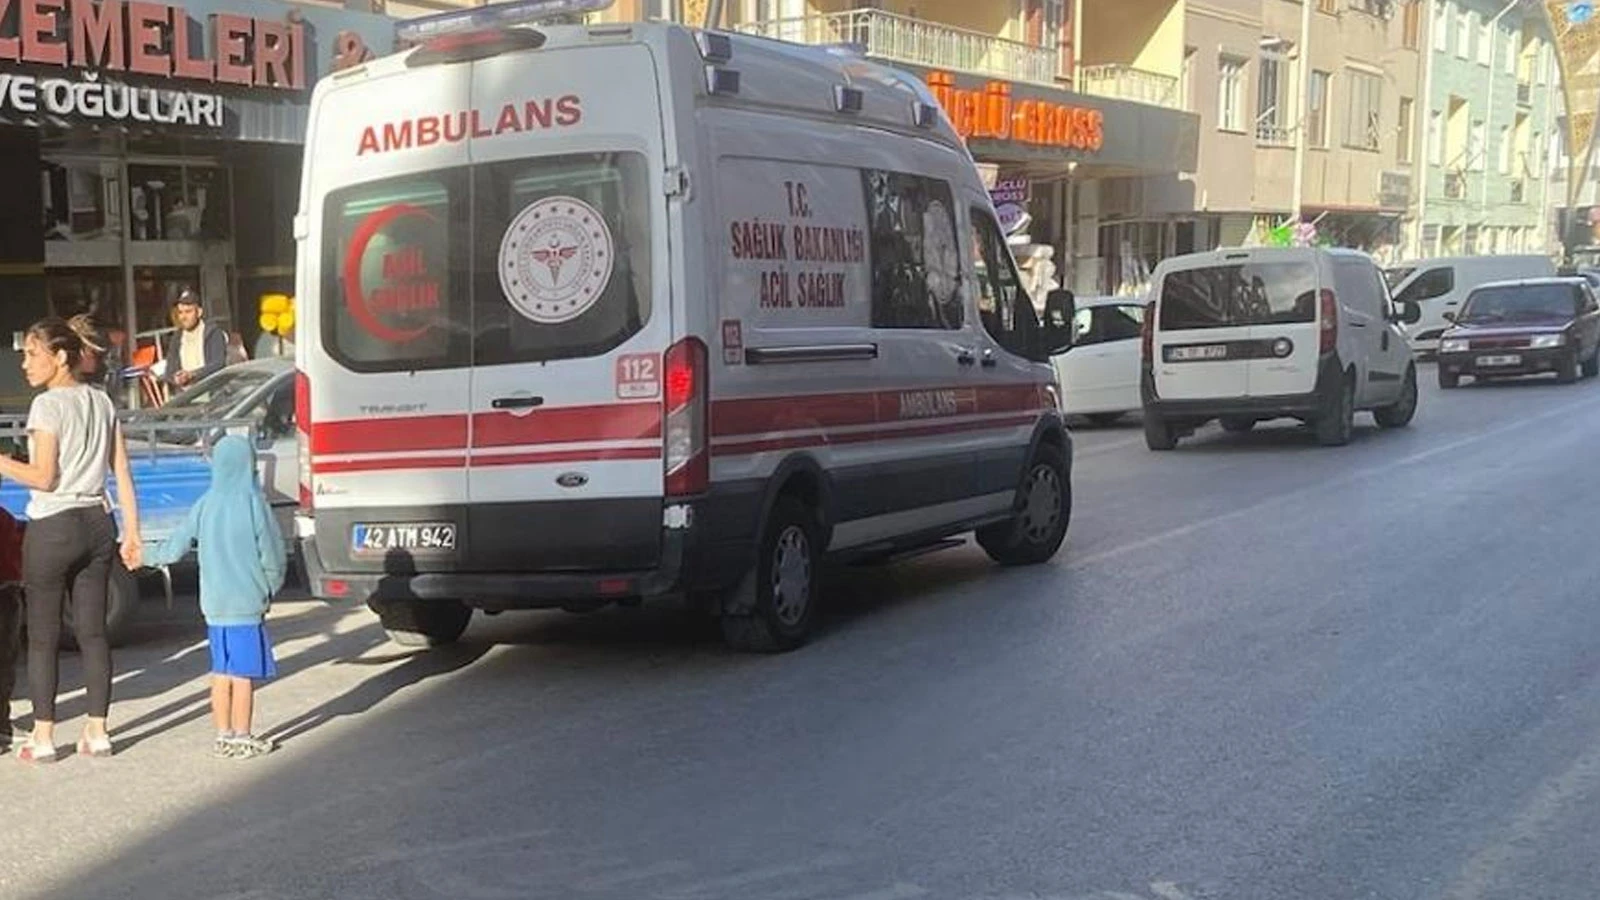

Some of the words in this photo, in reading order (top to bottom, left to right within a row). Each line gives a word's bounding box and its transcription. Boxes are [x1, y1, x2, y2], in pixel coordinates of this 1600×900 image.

[43, 71, 223, 126] OĞULLARI
[357, 95, 582, 156] AMBULANS
[784, 181, 812, 218] T.C.
[731, 217, 787, 260] SAĞLIK
[793, 224, 864, 262] BAKANLIĞI
[760, 265, 793, 308] ACİL
[797, 268, 846, 308] SAĞLIK
[622, 358, 655, 381] 112
[363, 527, 384, 549] 42
[386, 527, 419, 549] ATM
[421, 526, 454, 548] 942
